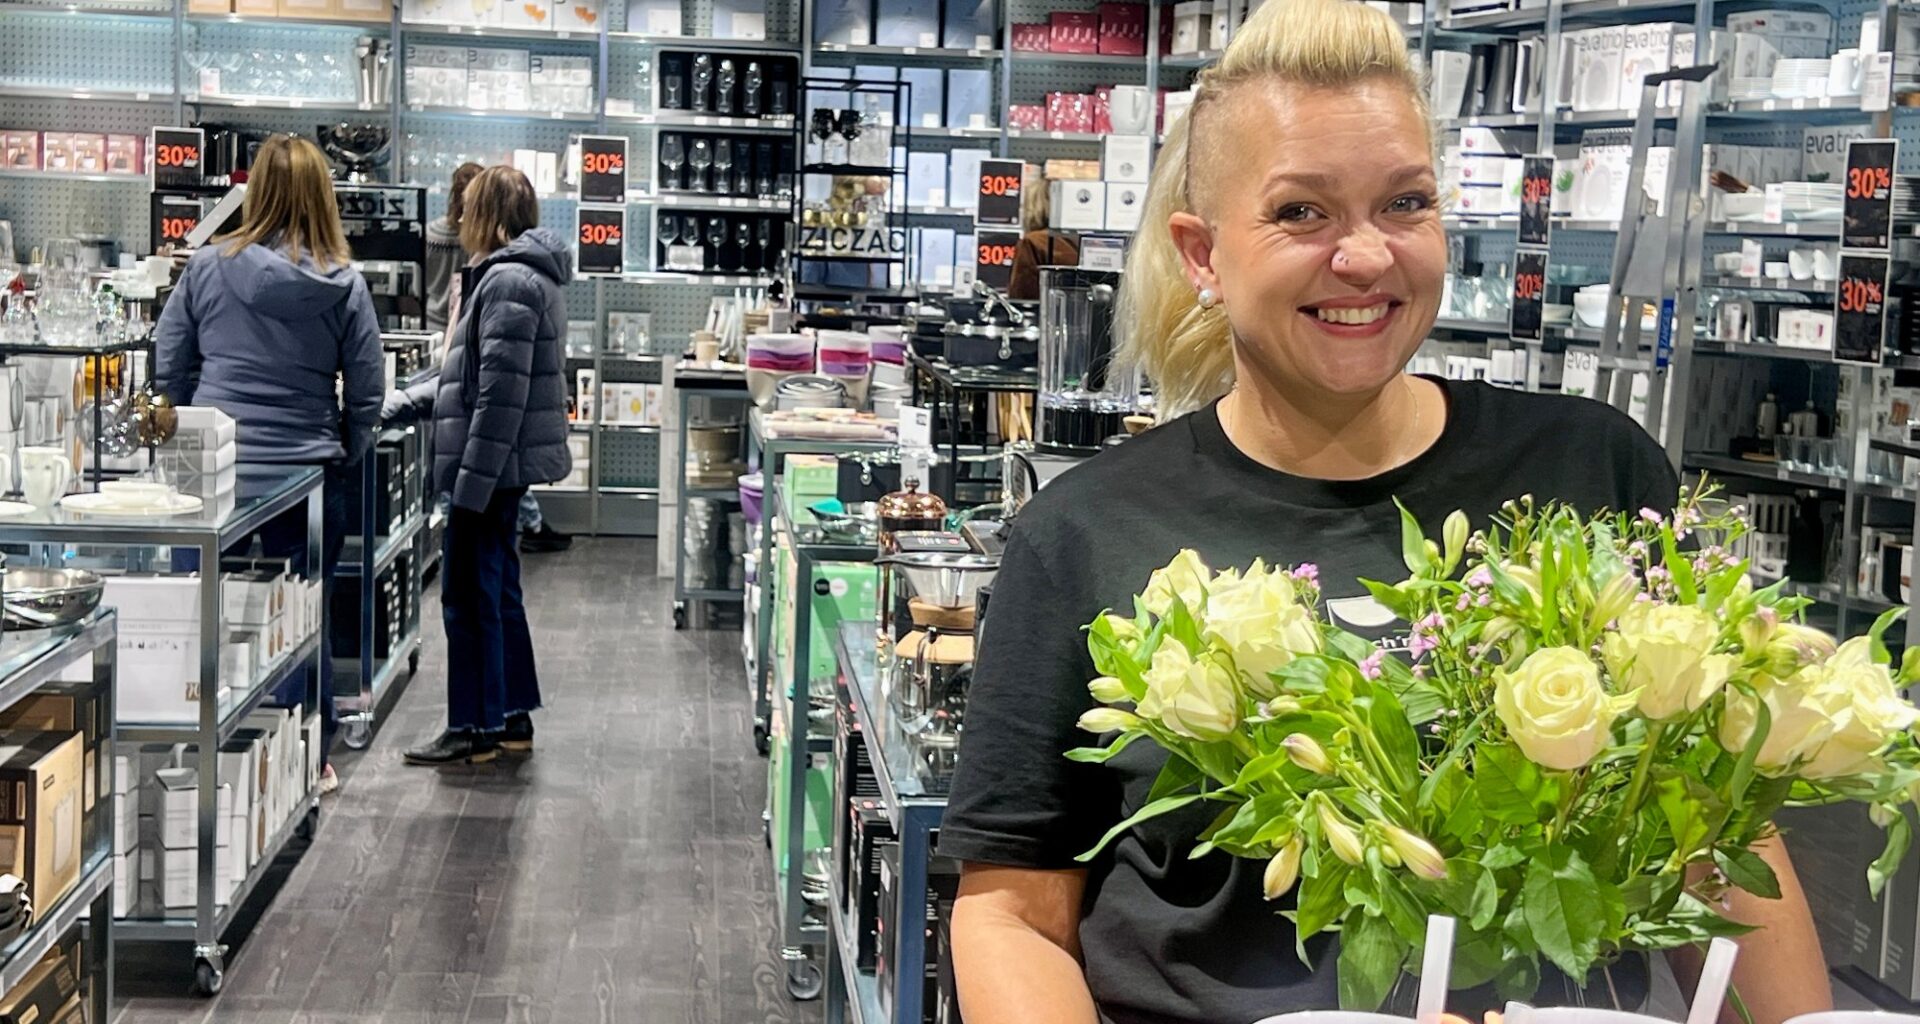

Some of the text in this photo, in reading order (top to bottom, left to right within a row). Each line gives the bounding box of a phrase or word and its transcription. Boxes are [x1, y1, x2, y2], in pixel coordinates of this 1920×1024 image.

[157, 145, 198, 167] 30%
[583, 152, 624, 173] 30%
[980, 175, 1020, 196] 30%
[1522, 177, 1551, 203] 30%
[1848, 167, 1890, 199] 30%
[580, 223, 621, 244] 30%
[800, 226, 905, 253] ZICZAC
[978, 245, 1016, 265] 30%
[1515, 273, 1543, 298] 30%
[1839, 280, 1882, 312] 30%
